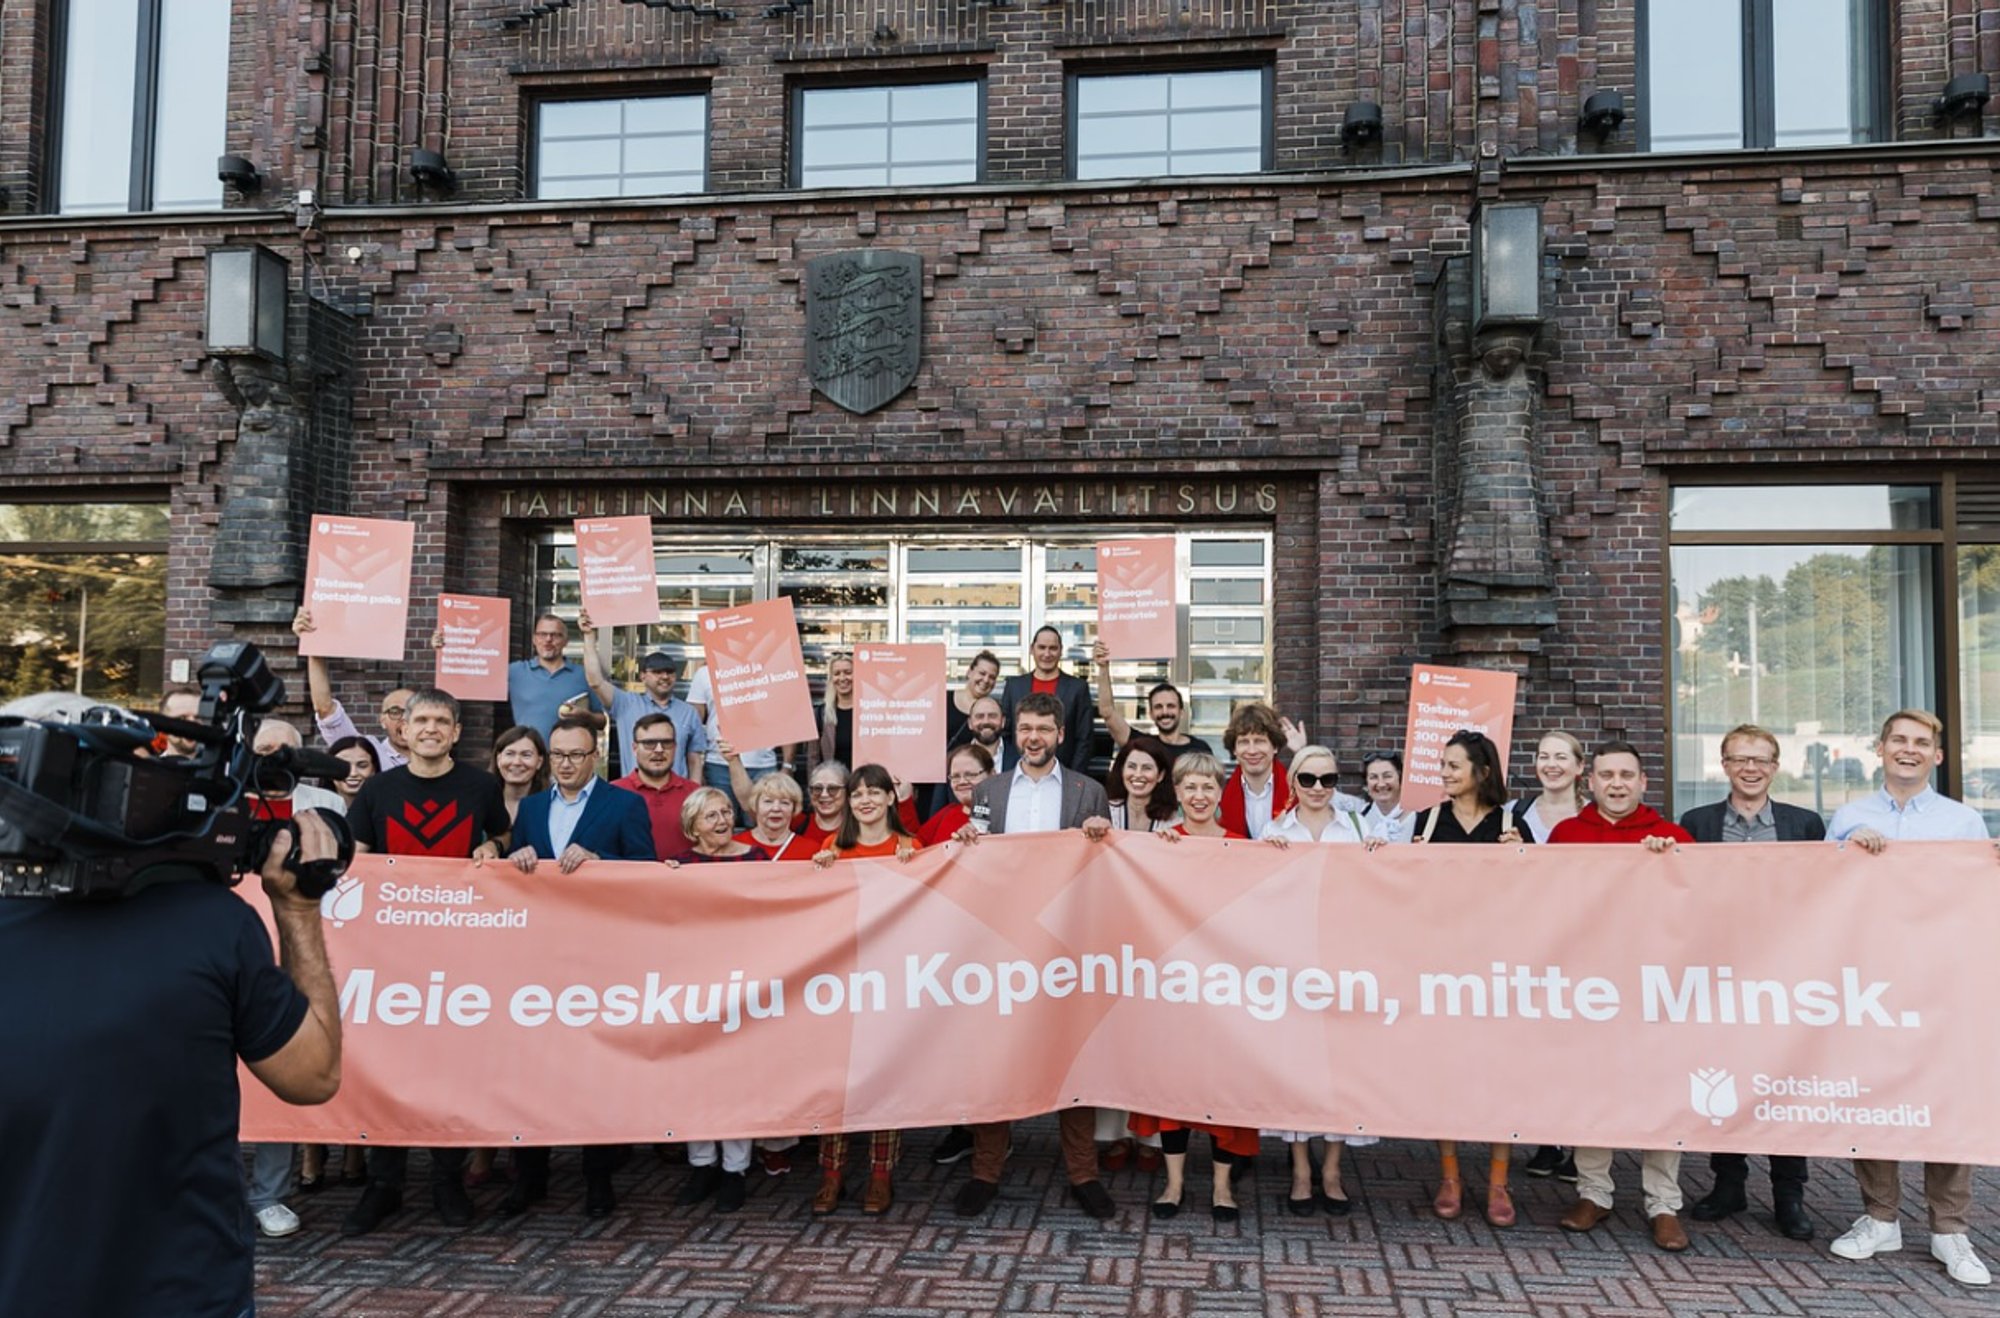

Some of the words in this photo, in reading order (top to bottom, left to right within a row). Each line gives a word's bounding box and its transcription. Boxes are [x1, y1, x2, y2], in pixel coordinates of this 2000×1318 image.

[502, 489, 748, 516] TALLINNA
[822, 484, 1278, 515] LINNAVALITSUS
[1416, 702, 1469, 716] Tõstame
[1414, 731, 1439, 743] 300
[1412, 747, 1439, 760] ning
[378, 881, 484, 905] Sotsiaal-
[375, 905, 528, 929] demokraadid
[338, 967, 492, 1027] Meie
[508, 969, 785, 1033] eeskuju
[803, 968, 887, 1016] on
[905, 944, 1401, 1026] Kopenhaagen,
[1419, 961, 1621, 1022] mitte
[1640, 964, 1922, 1028] Minsk.
[1752, 1073, 1871, 1099] Sotsiaal-
[1754, 1100, 1931, 1128] demokraadid
